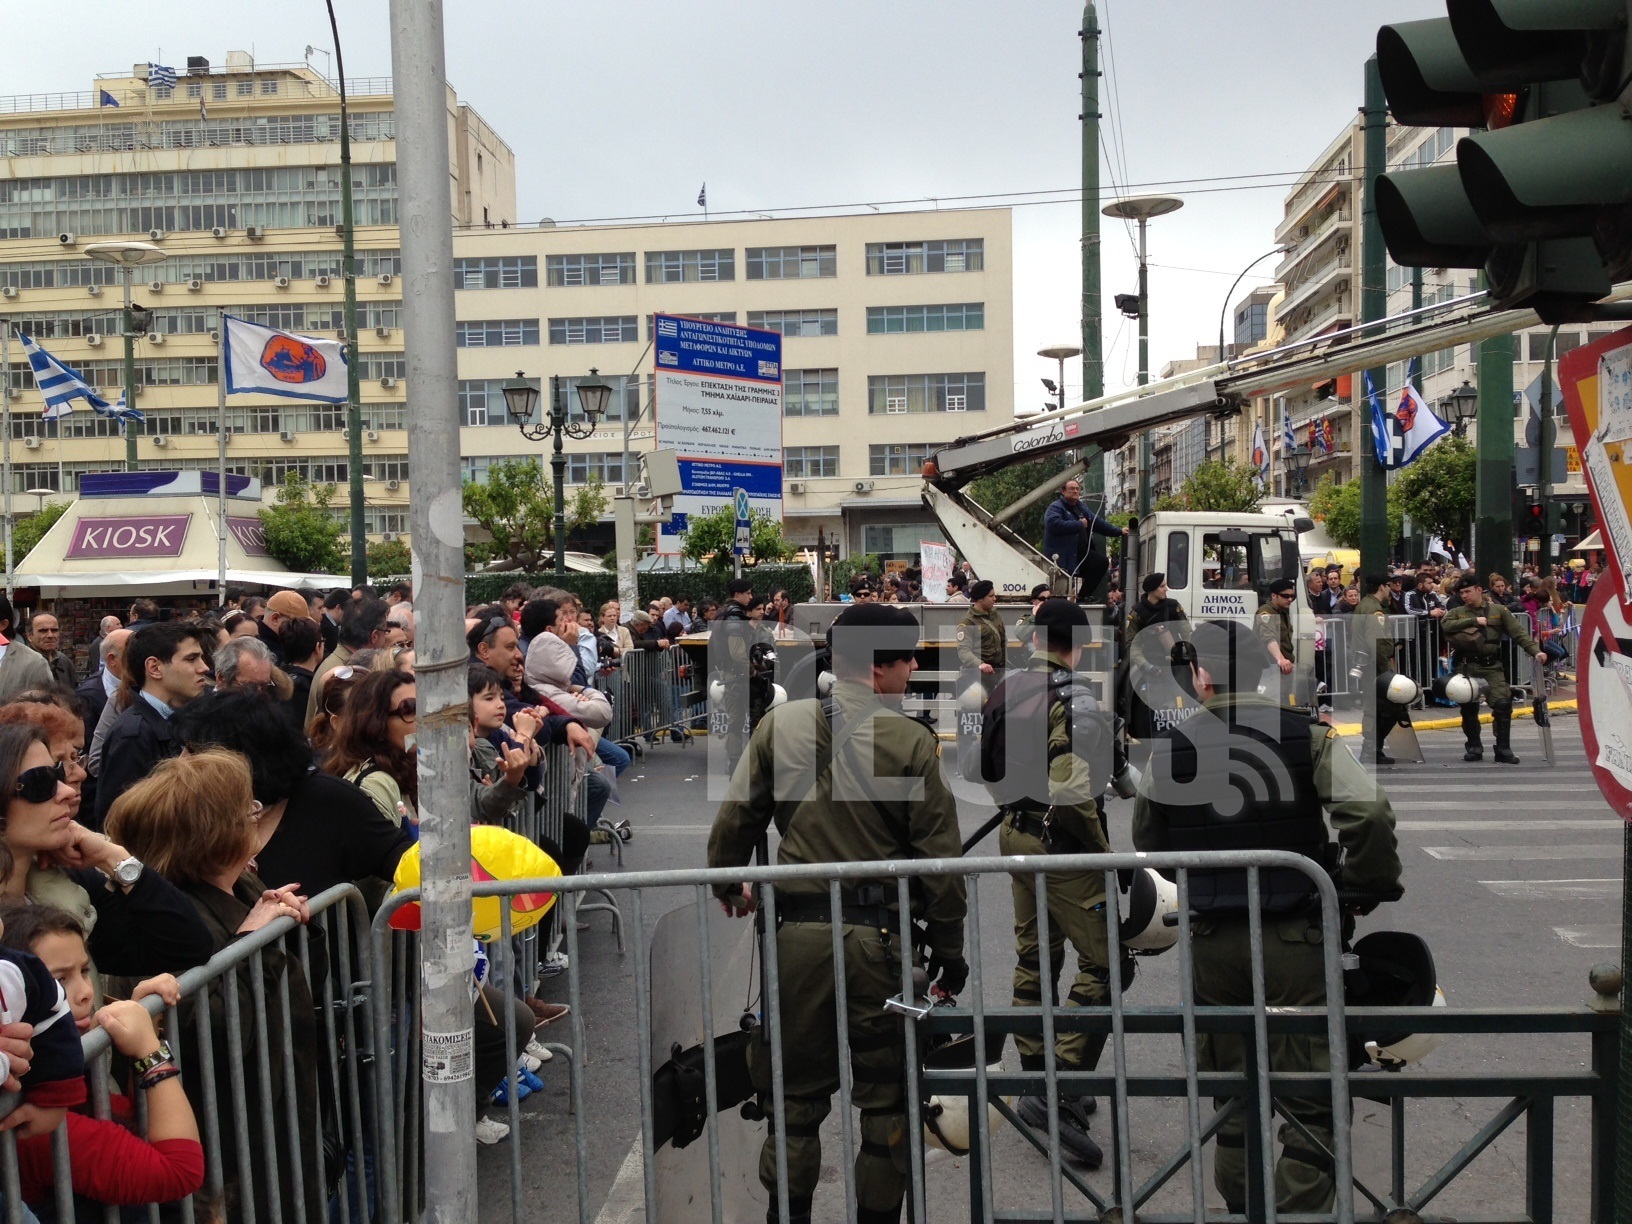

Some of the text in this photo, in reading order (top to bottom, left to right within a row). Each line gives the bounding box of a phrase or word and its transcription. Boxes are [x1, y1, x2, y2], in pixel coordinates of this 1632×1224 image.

[717, 346, 728, 354] ΚΑΙ
[692, 358, 715, 368] ΑΤΤΙΚΟ
[715, 361, 735, 371] ΜΕΤΡΟ
[701, 381, 733, 392] ΕΠΕΚΤΑΣΗ
[734, 384, 747, 393] ΤΗΣ
[747, 386, 776, 396] ΓΡΑΜΜΗΣ
[701, 391, 725, 399] ΤΜΗΜΑ
[1013, 424, 1064, 452] Colombo
[81, 525, 175, 549] KIOSK
[1002, 583, 1027, 592] 2004
[1203, 595, 1243, 604] ΔΗΜΟΣ
[1201, 605, 1246, 615] ΠΕΙΡΑΙΑ
